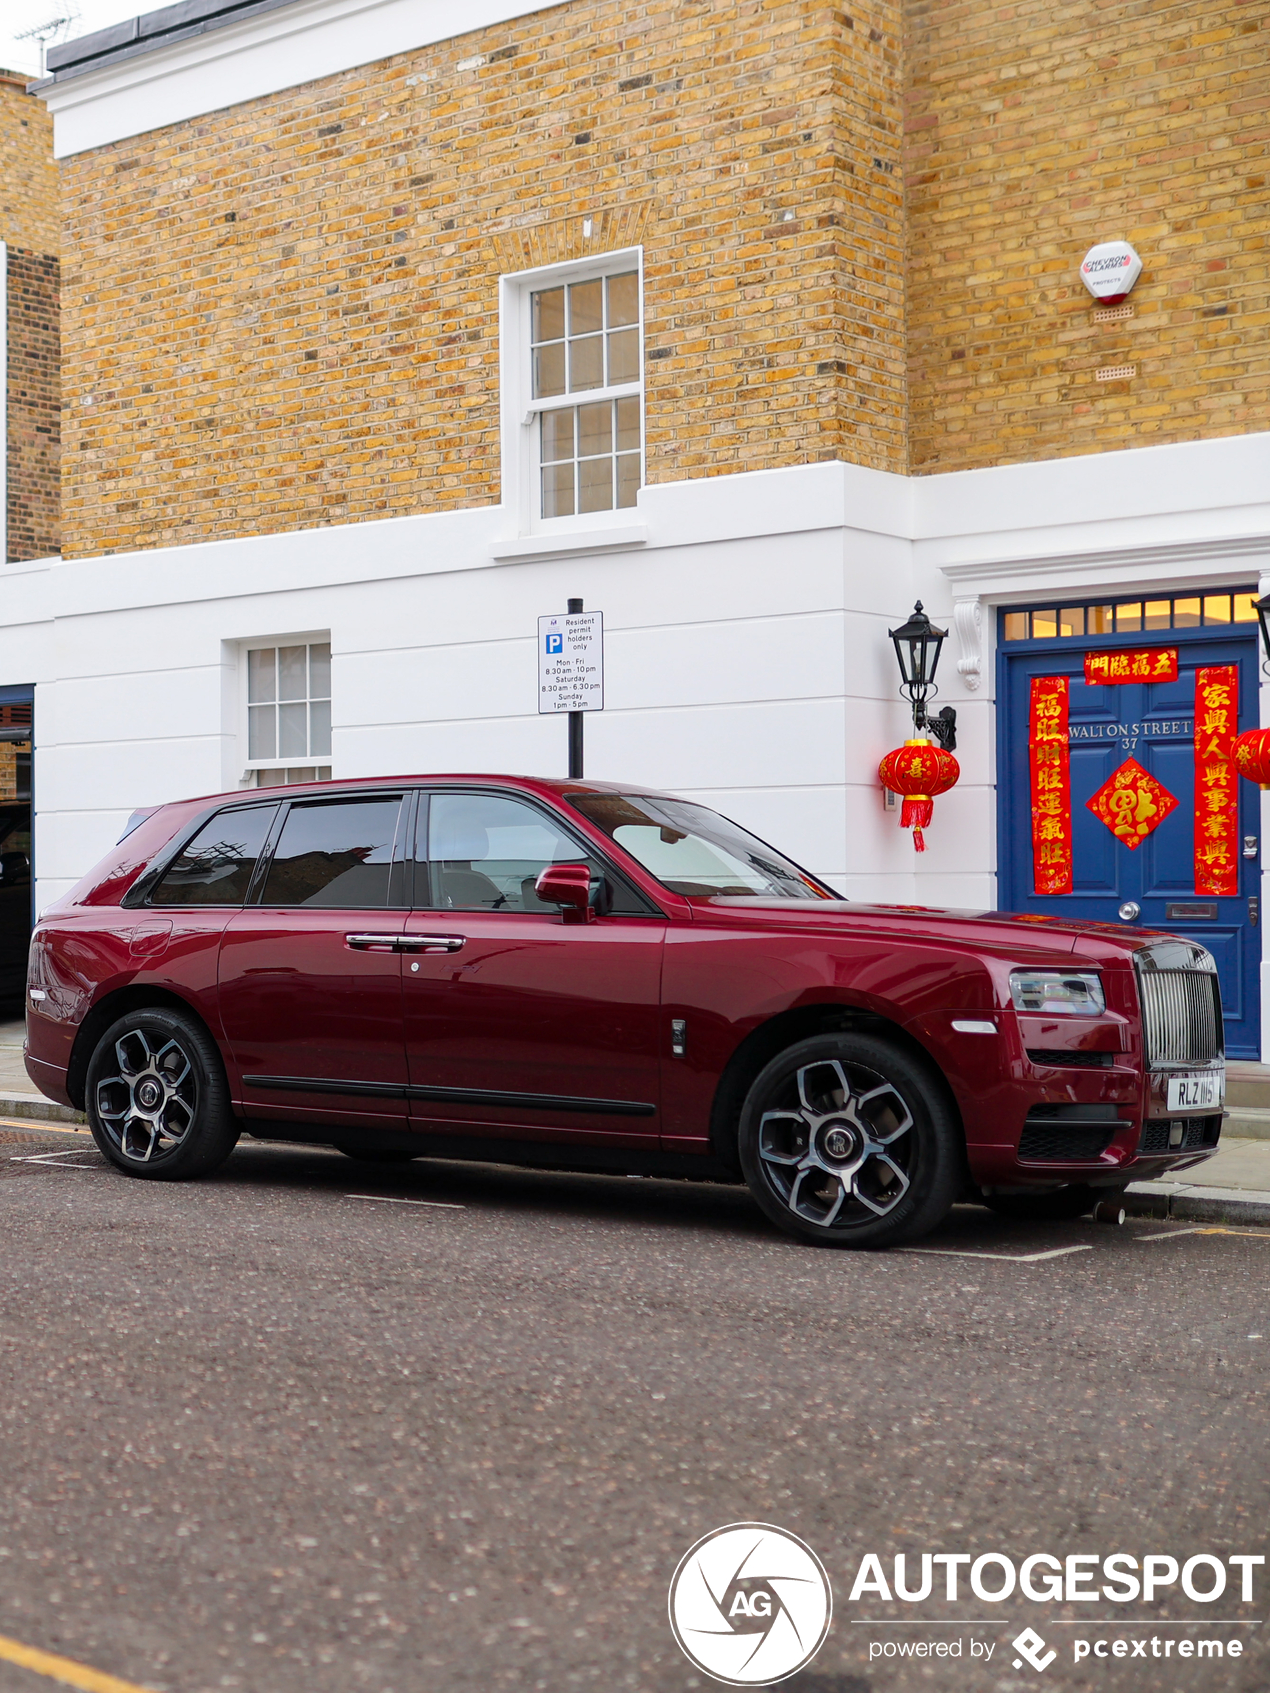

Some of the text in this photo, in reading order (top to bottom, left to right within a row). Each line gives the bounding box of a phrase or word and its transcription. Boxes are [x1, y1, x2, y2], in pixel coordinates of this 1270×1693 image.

[1087, 255, 1127, 267] CHEVRON
[1089, 261, 1122, 272] ALARMS
[1093, 277, 1121, 286] PROTECTS
[566, 618, 594, 626] Resident
[569, 626, 591, 635] permit
[549, 635, 561, 653] P
[568, 635, 592, 643] holders
[555, 675, 585, 683] Saturday
[1068, 721, 1191, 738] WALTON STREET
[1122, 738, 1138, 750] 37
[1201, 683, 1231, 865] 家興人興事業興
[1178, 1082, 1199, 1105] RLZ
